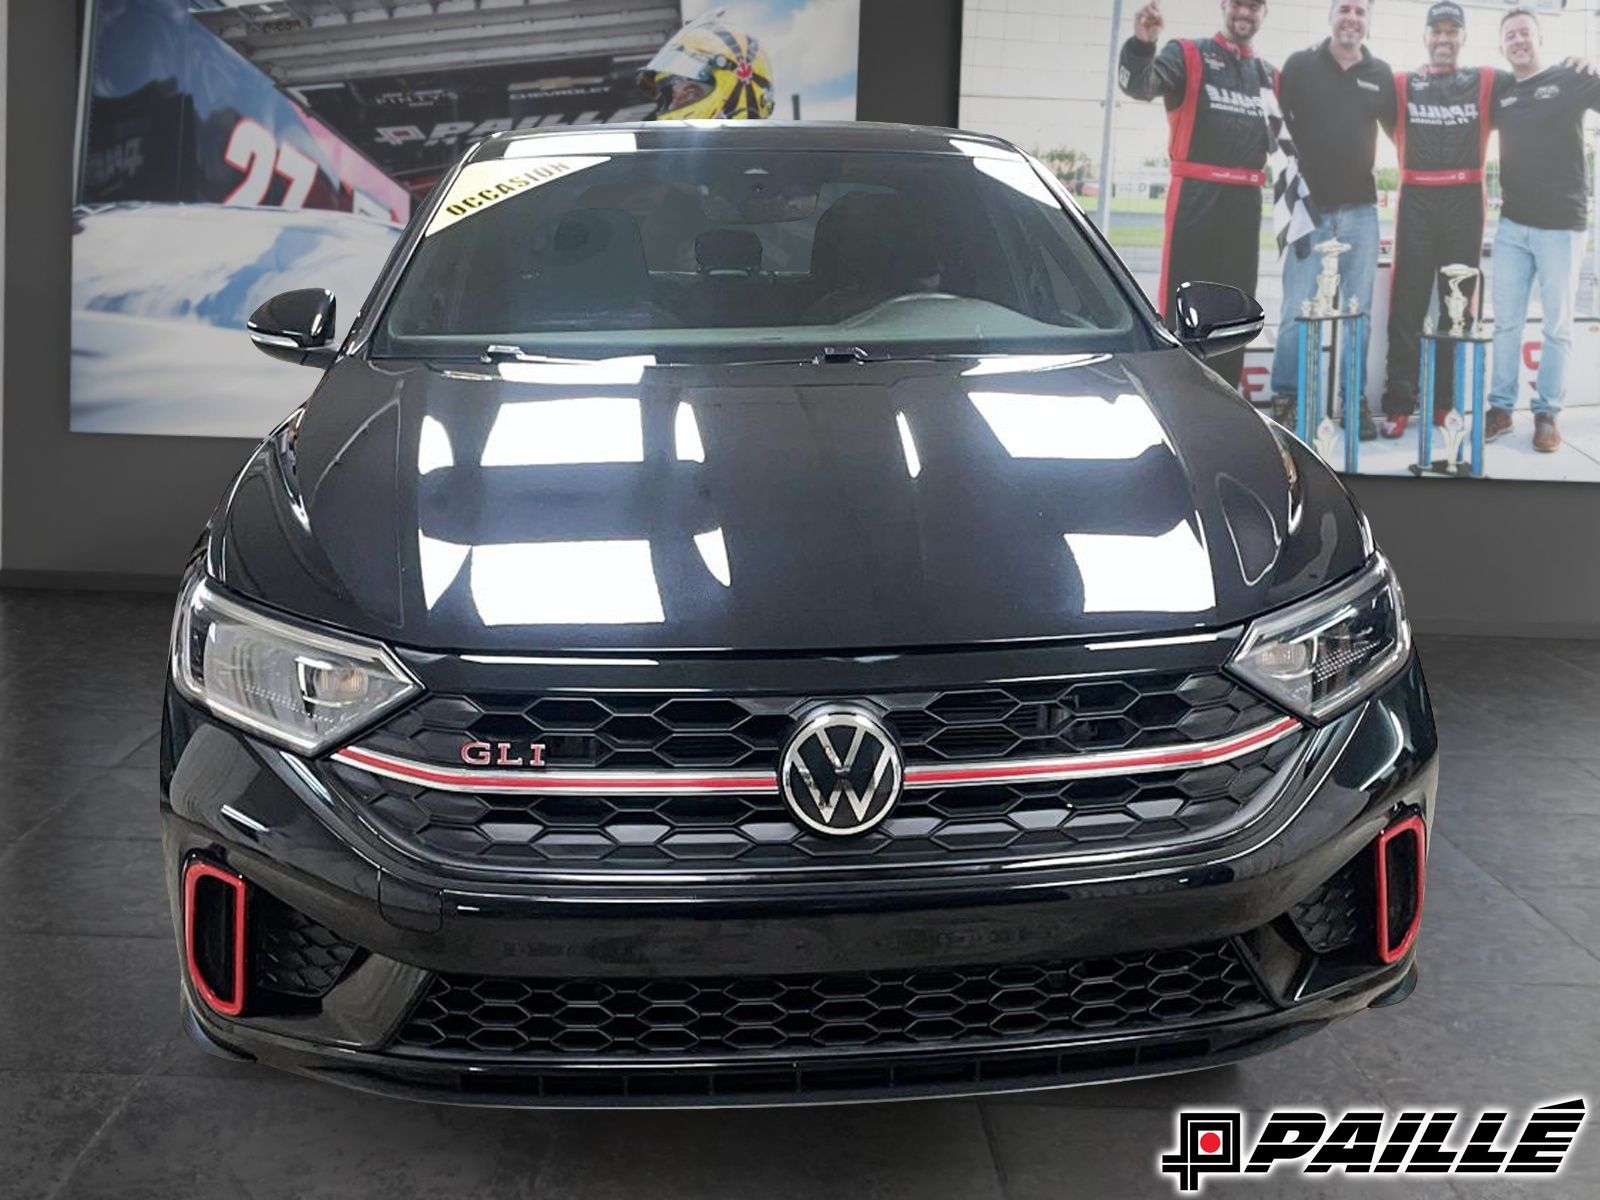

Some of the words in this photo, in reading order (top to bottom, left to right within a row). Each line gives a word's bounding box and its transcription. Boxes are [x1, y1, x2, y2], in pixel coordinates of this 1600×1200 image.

[509, 85, 611, 100] CHEVROLET
[223, 117, 318, 211] 27
[447, 161, 571, 216] OCCASION
[461, 741, 546, 767] GLI
